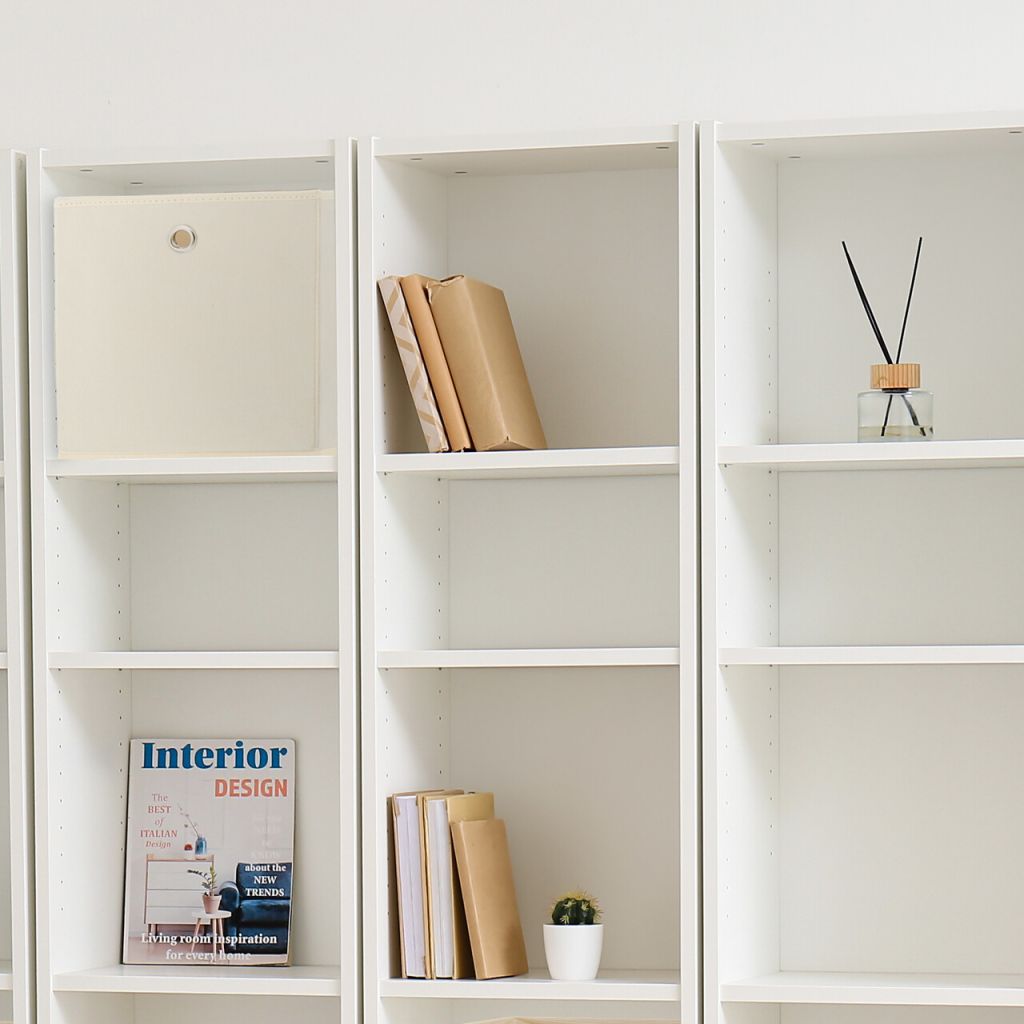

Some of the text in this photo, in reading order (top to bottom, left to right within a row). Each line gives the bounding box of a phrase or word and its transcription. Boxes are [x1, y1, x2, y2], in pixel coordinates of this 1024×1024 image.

[141, 740, 288, 769] Interior
[215, 779, 288, 797] DESIGN
[152, 793, 169, 802] The
[148, 805, 172, 814] BEST
[155, 817, 165, 828] of
[140, 829, 178, 838] ITALIAN
[145, 840, 172, 849] Design
[244, 863, 287, 872] about the
[253, 875, 278, 884] NEW
[245, 887, 285, 897] TRENDS
[141, 932, 278, 946] Living room inspiration
[165, 949, 252, 963] for every home
